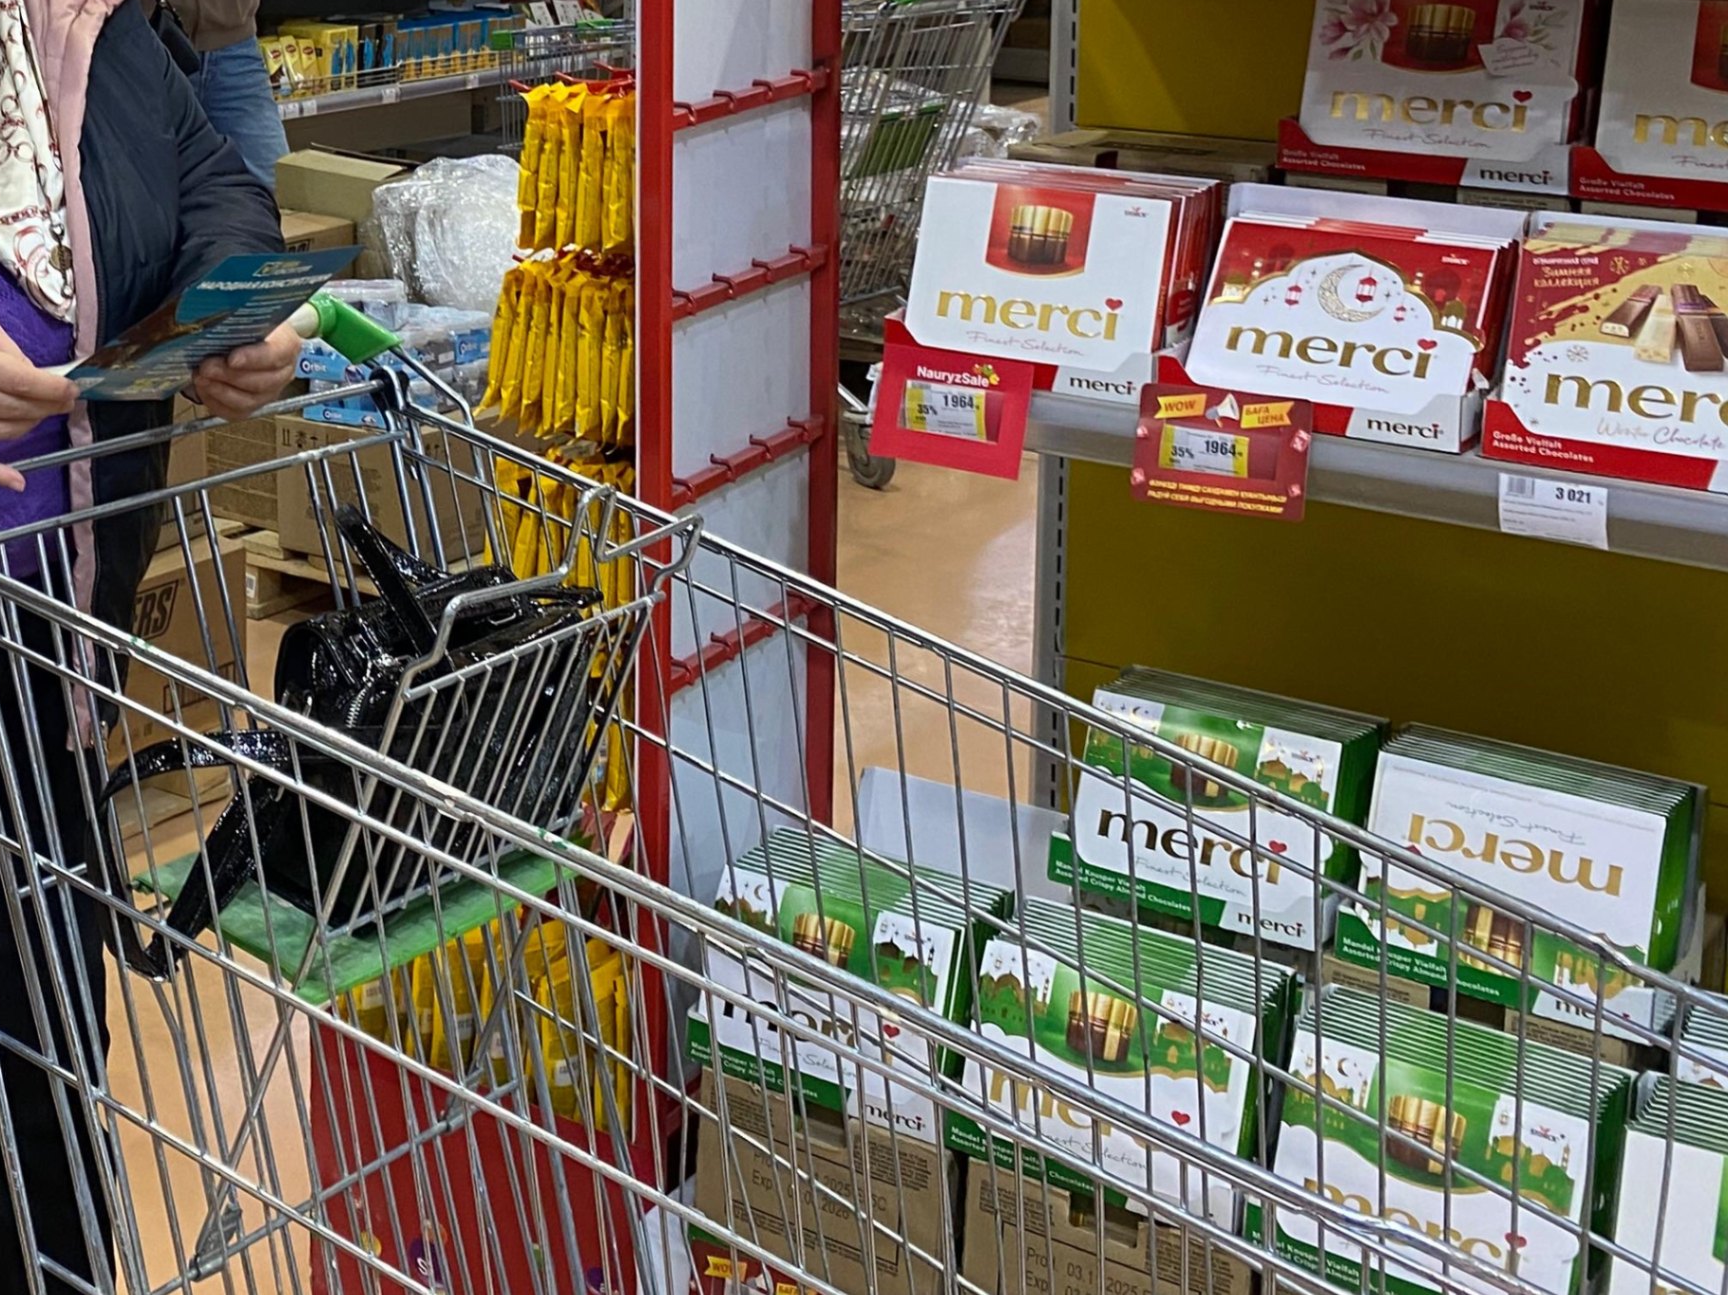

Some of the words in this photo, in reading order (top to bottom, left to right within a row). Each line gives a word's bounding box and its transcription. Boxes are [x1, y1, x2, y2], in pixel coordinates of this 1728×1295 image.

[1328, 89, 1533, 134] merci
[1479, 168, 1550, 185] merci
[936, 289, 1123, 341] merci
[1225, 324, 1437, 379] merci
[300, 357, 327, 375] Orbit
[917, 365, 989, 388] NauryzSale
[1070, 377, 1133, 395] merci
[1544, 373, 1728, 423] mer
[1163, 399, 1196, 413] WOW
[1367, 419, 1440, 439] merci
[1492, 439, 1536, 454] Assorted
[1539, 447, 1594, 463] Chocolates
[1097, 808, 1287, 885] merci
[1406, 812, 1623, 898] merci
[1237, 909, 1304, 938] merci
[1455, 977, 1500, 997] hocolates
